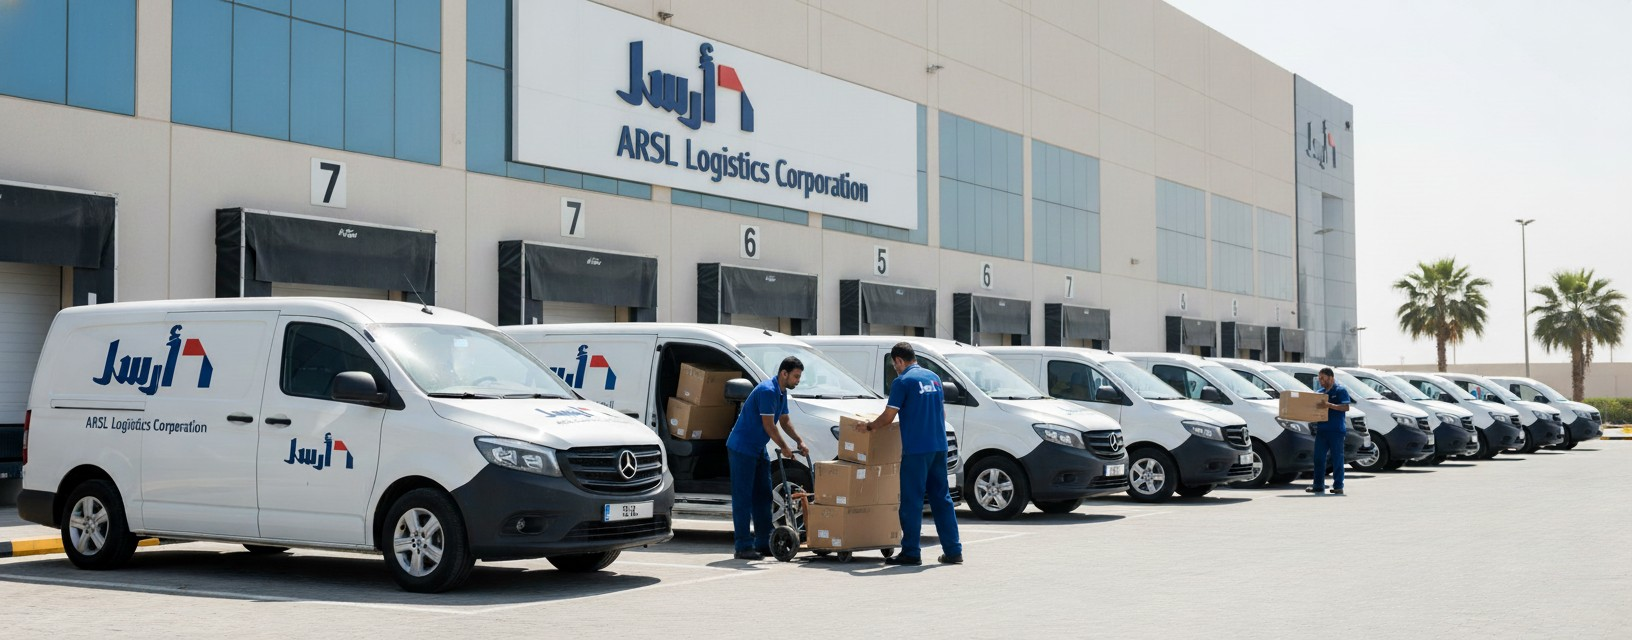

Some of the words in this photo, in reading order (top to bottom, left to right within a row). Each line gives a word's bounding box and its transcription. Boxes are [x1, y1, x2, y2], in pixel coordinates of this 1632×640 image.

[616, 41, 717, 130] أرسل
[616, 125, 679, 167] ARSL
[686, 138, 770, 183] Logistics
[775, 159, 869, 203] Corporation
[320, 161, 341, 204] 7
[566, 201, 582, 235] 7
[744, 226, 757, 258] 6
[877, 248, 887, 275] 5
[983, 263, 991, 287] 6
[1065, 276, 1073, 297] 7
[92, 324, 183, 396] أرسل
[85, 416, 108, 429] ARSL
[284, 432, 333, 471] أرسل
